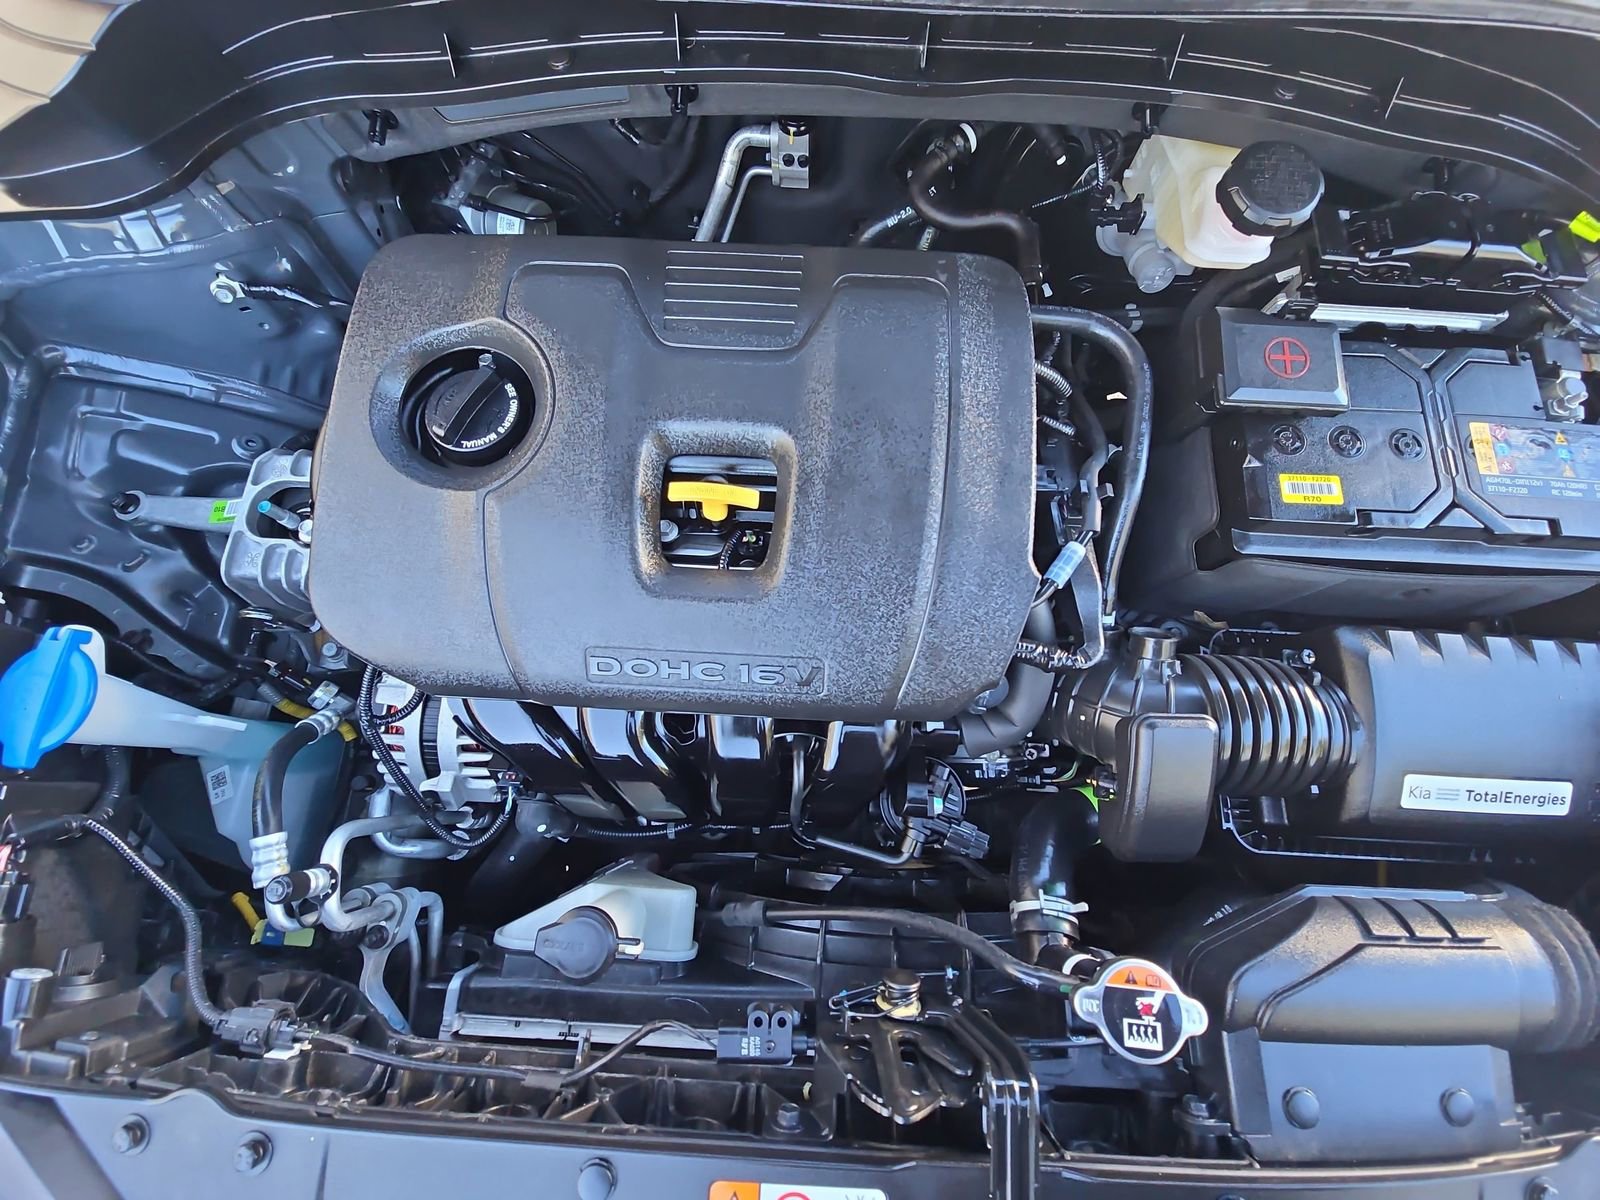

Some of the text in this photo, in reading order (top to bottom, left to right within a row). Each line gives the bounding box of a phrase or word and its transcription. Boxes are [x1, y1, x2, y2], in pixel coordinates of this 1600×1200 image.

[461, 382, 518, 448] SEE OWNER'S MANUAL
[589, 655, 824, 687] DOHC 16V
[1408, 785, 1567, 807] Kia TotalEnergies
